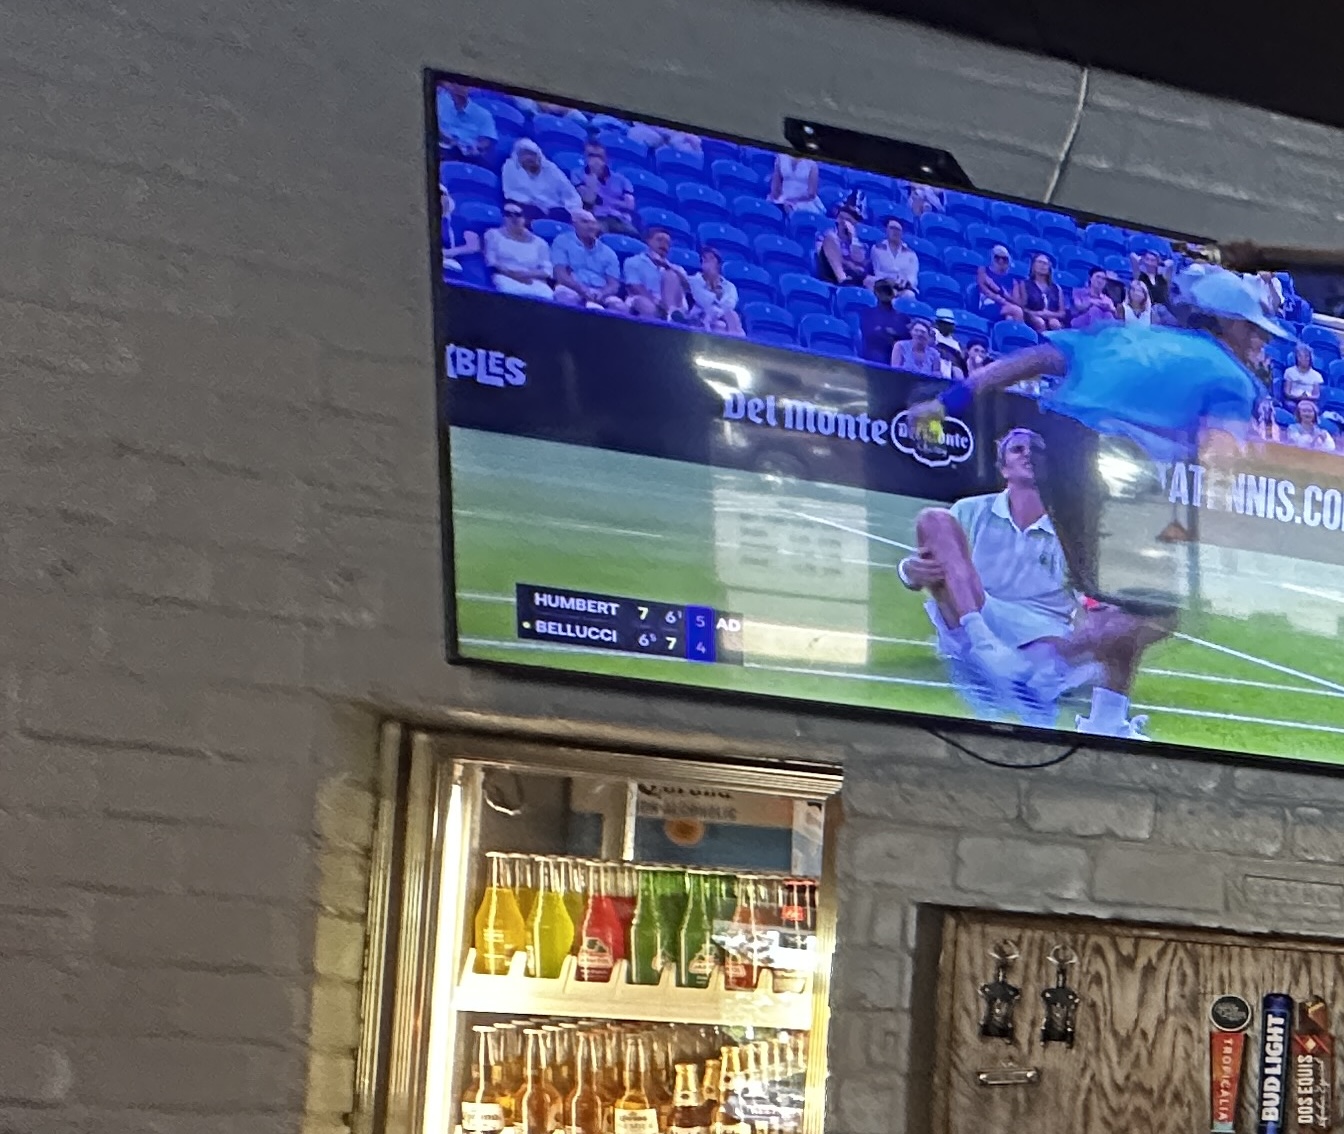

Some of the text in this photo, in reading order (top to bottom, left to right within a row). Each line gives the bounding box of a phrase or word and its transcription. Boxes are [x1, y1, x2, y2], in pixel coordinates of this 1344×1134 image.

[723, 392, 777, 427] Del
[783, 398, 889, 446] Monte
[534, 591, 741, 632] HUMBERT 7 5 AD
[535, 619, 618, 643] BELLUCCI
[665, 635, 677, 650] 7
[1218, 1038, 1233, 1122] TROPICALIA
[1262, 1014, 1286, 1122] BUD LIGHT
[1297, 1055, 1314, 1124] DOS EQUIS
